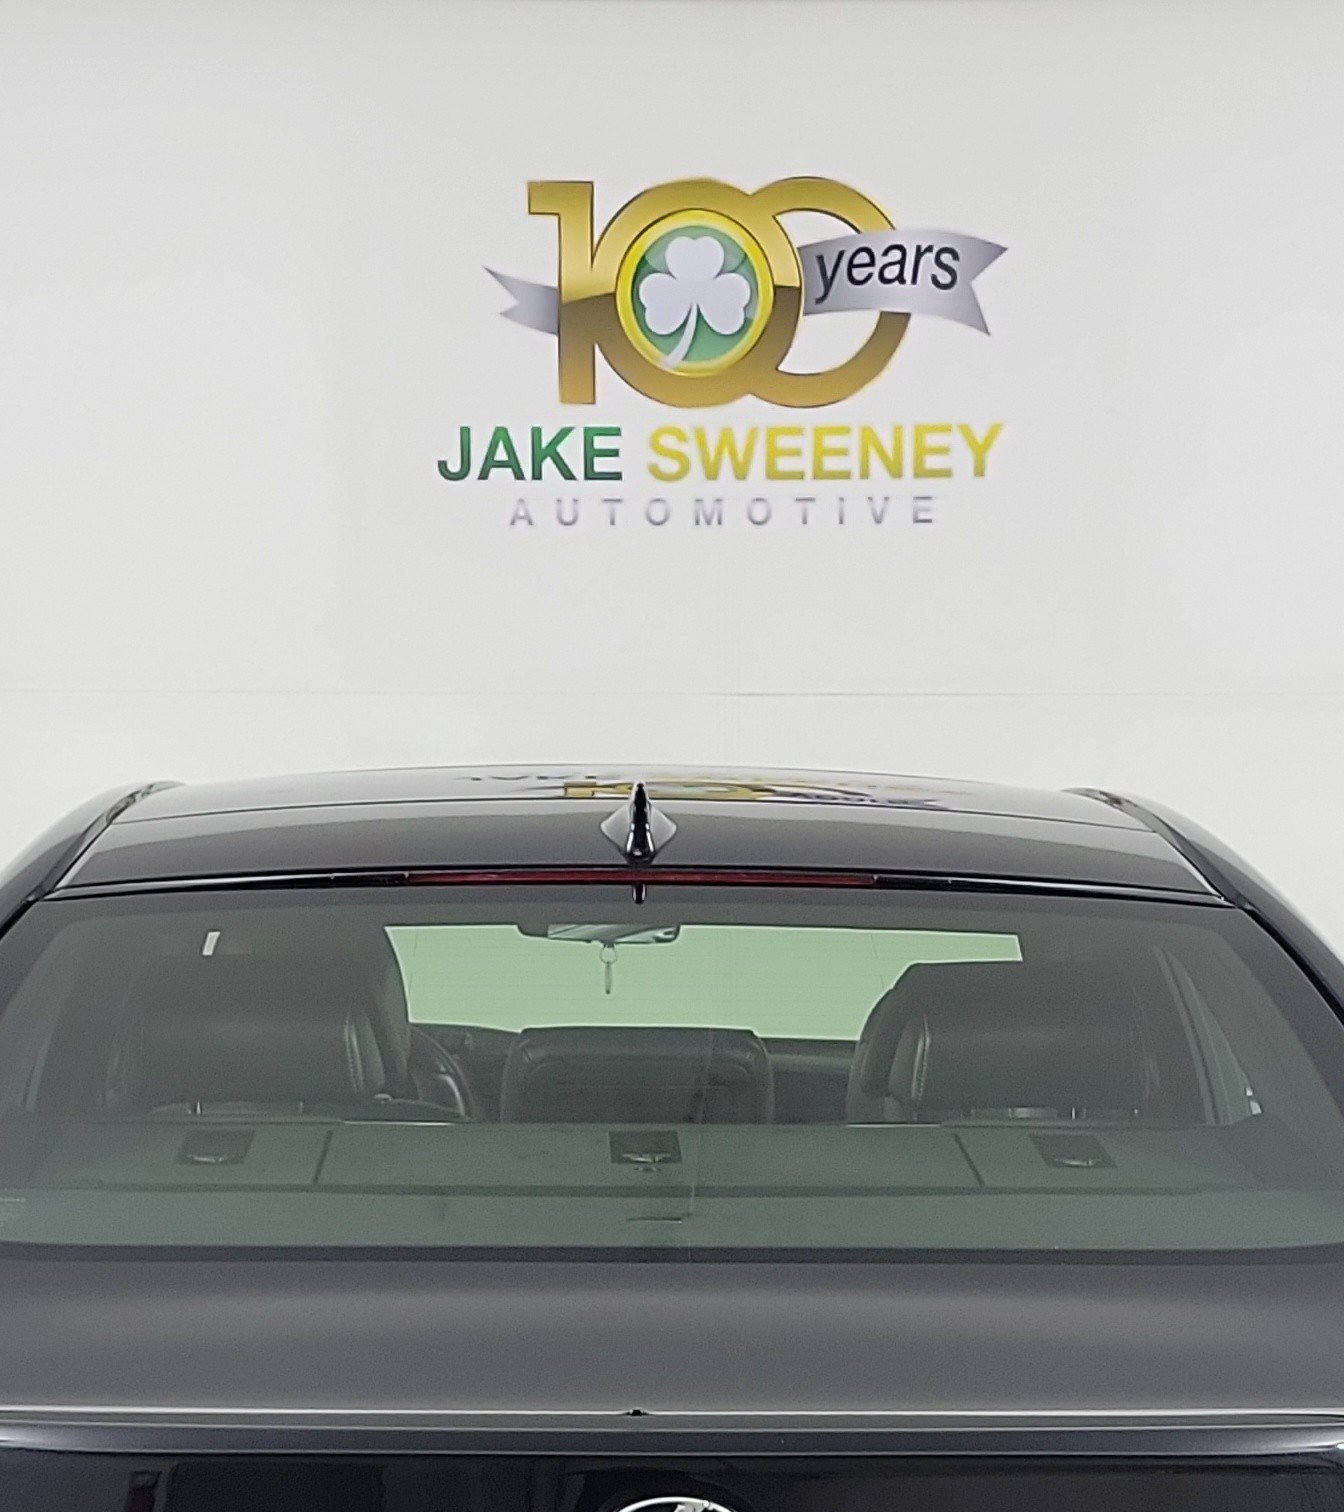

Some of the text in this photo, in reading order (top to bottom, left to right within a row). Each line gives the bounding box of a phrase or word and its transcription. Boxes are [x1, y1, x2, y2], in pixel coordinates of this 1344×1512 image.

[527, 176, 960, 409] 100 years
[437, 422, 1003, 482] JAKE SWEENEY
[509, 496, 936, 527] AUTOMOTIVE
